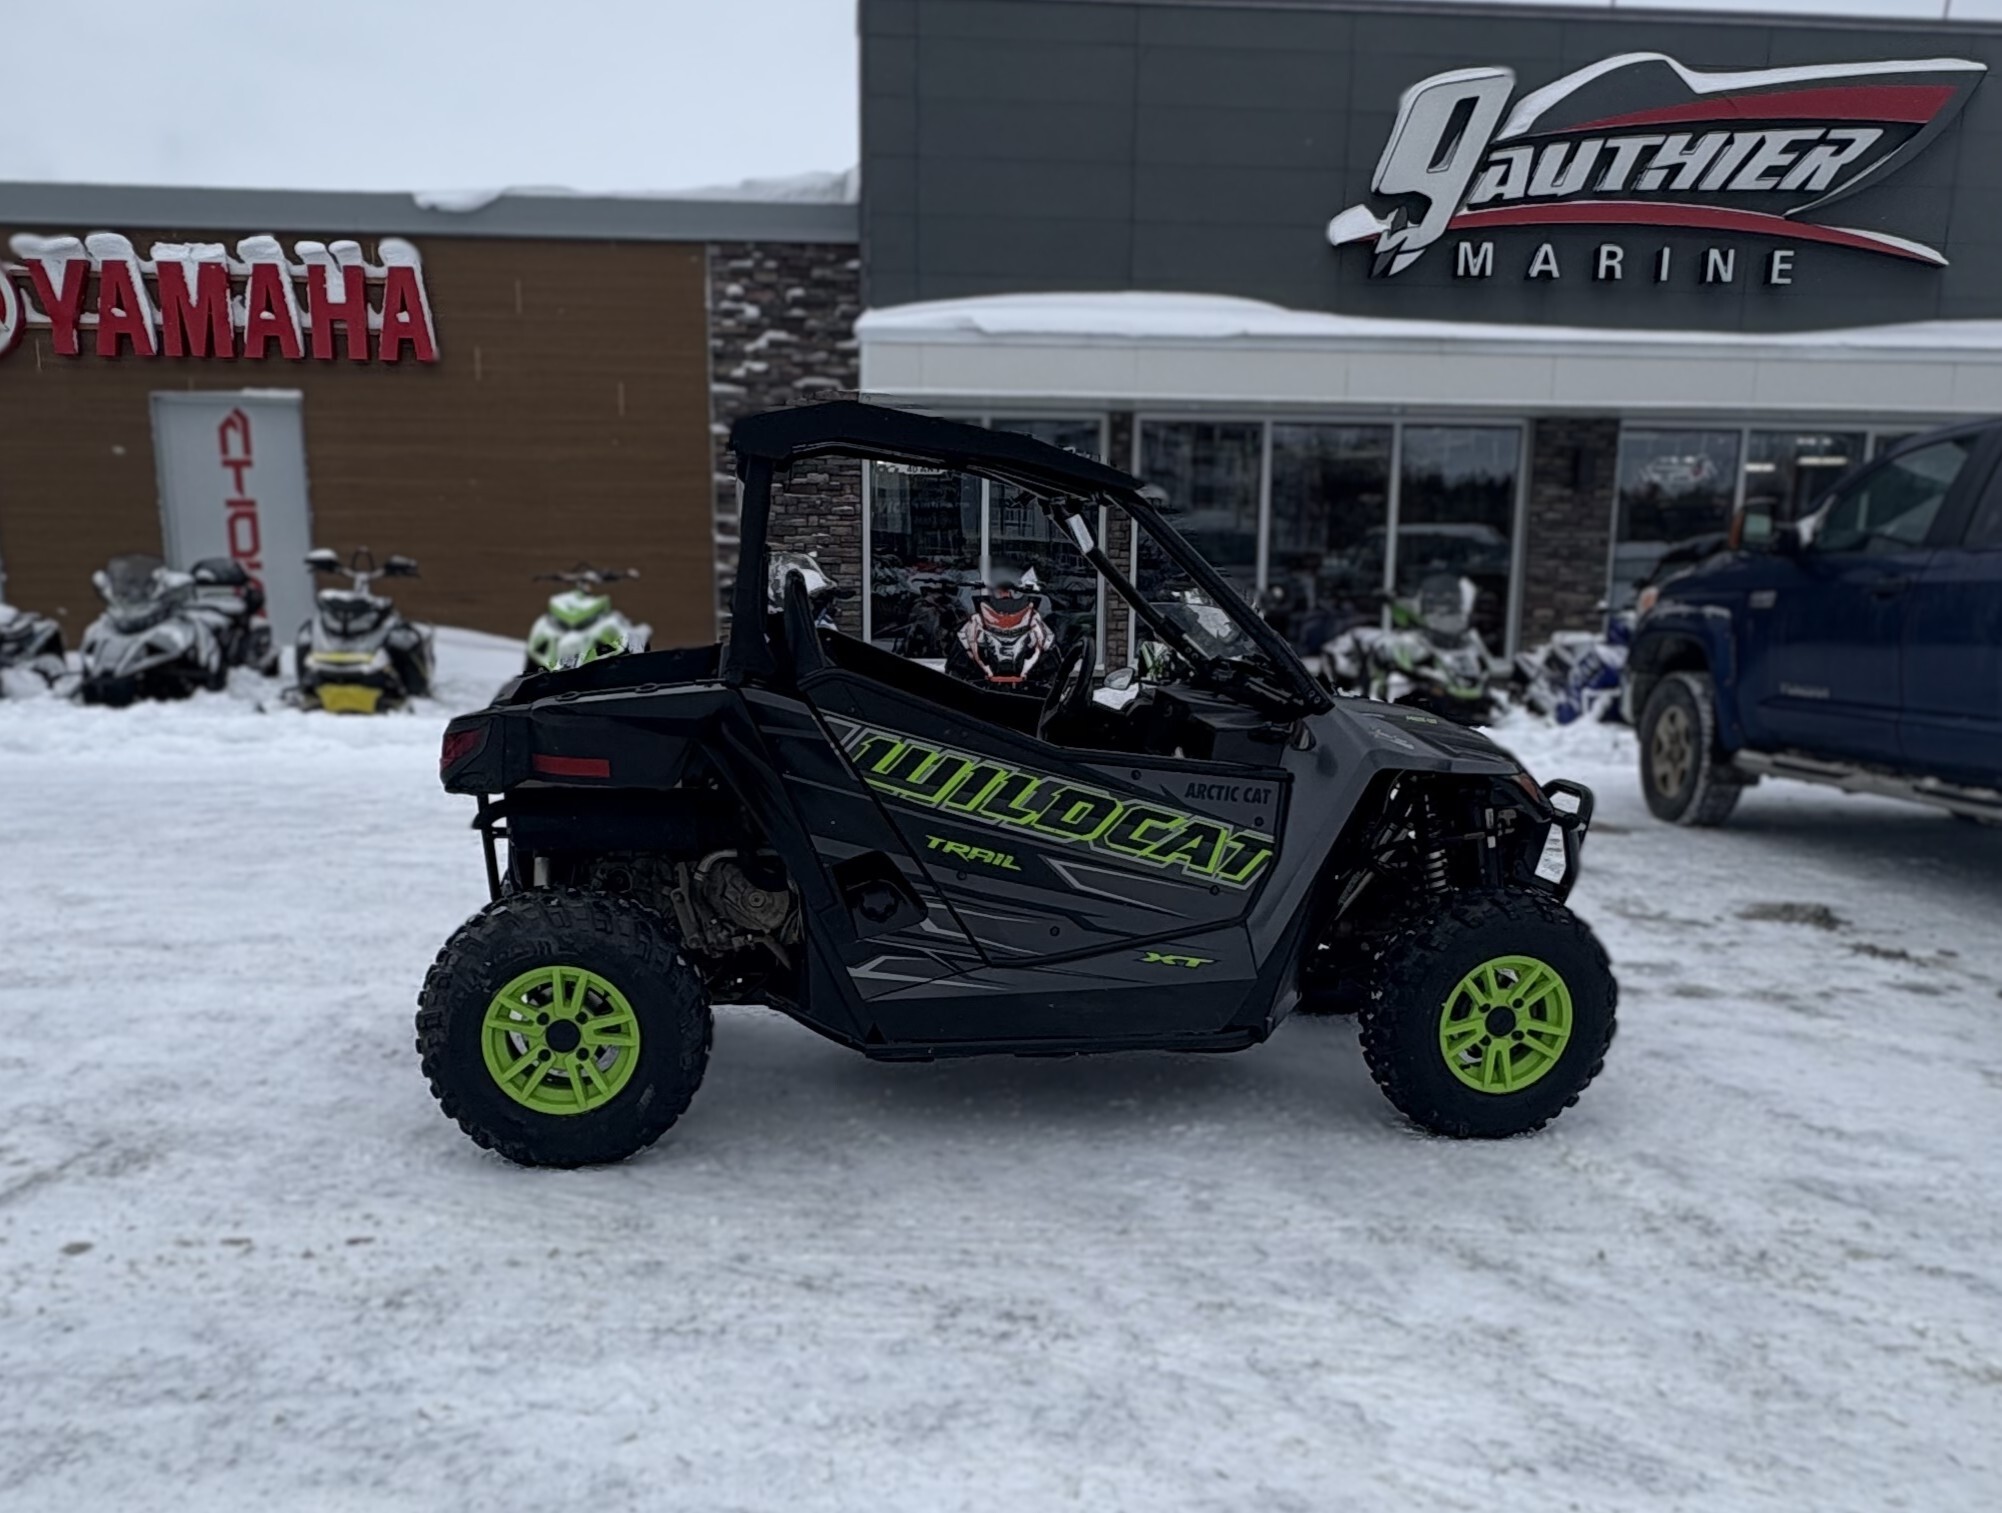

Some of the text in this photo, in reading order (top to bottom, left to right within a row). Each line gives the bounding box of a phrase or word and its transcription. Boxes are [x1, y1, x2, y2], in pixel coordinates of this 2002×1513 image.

[1456, 241, 1796, 285] MARINE
[24, 257, 439, 362] YAMAHA
[853, 733, 1274, 884] WILDCAT
[1184, 782, 1272, 804] ARCTIC CAT
[925, 834, 1022, 872] TRAIL
[1137, 950, 1217, 970] XT
